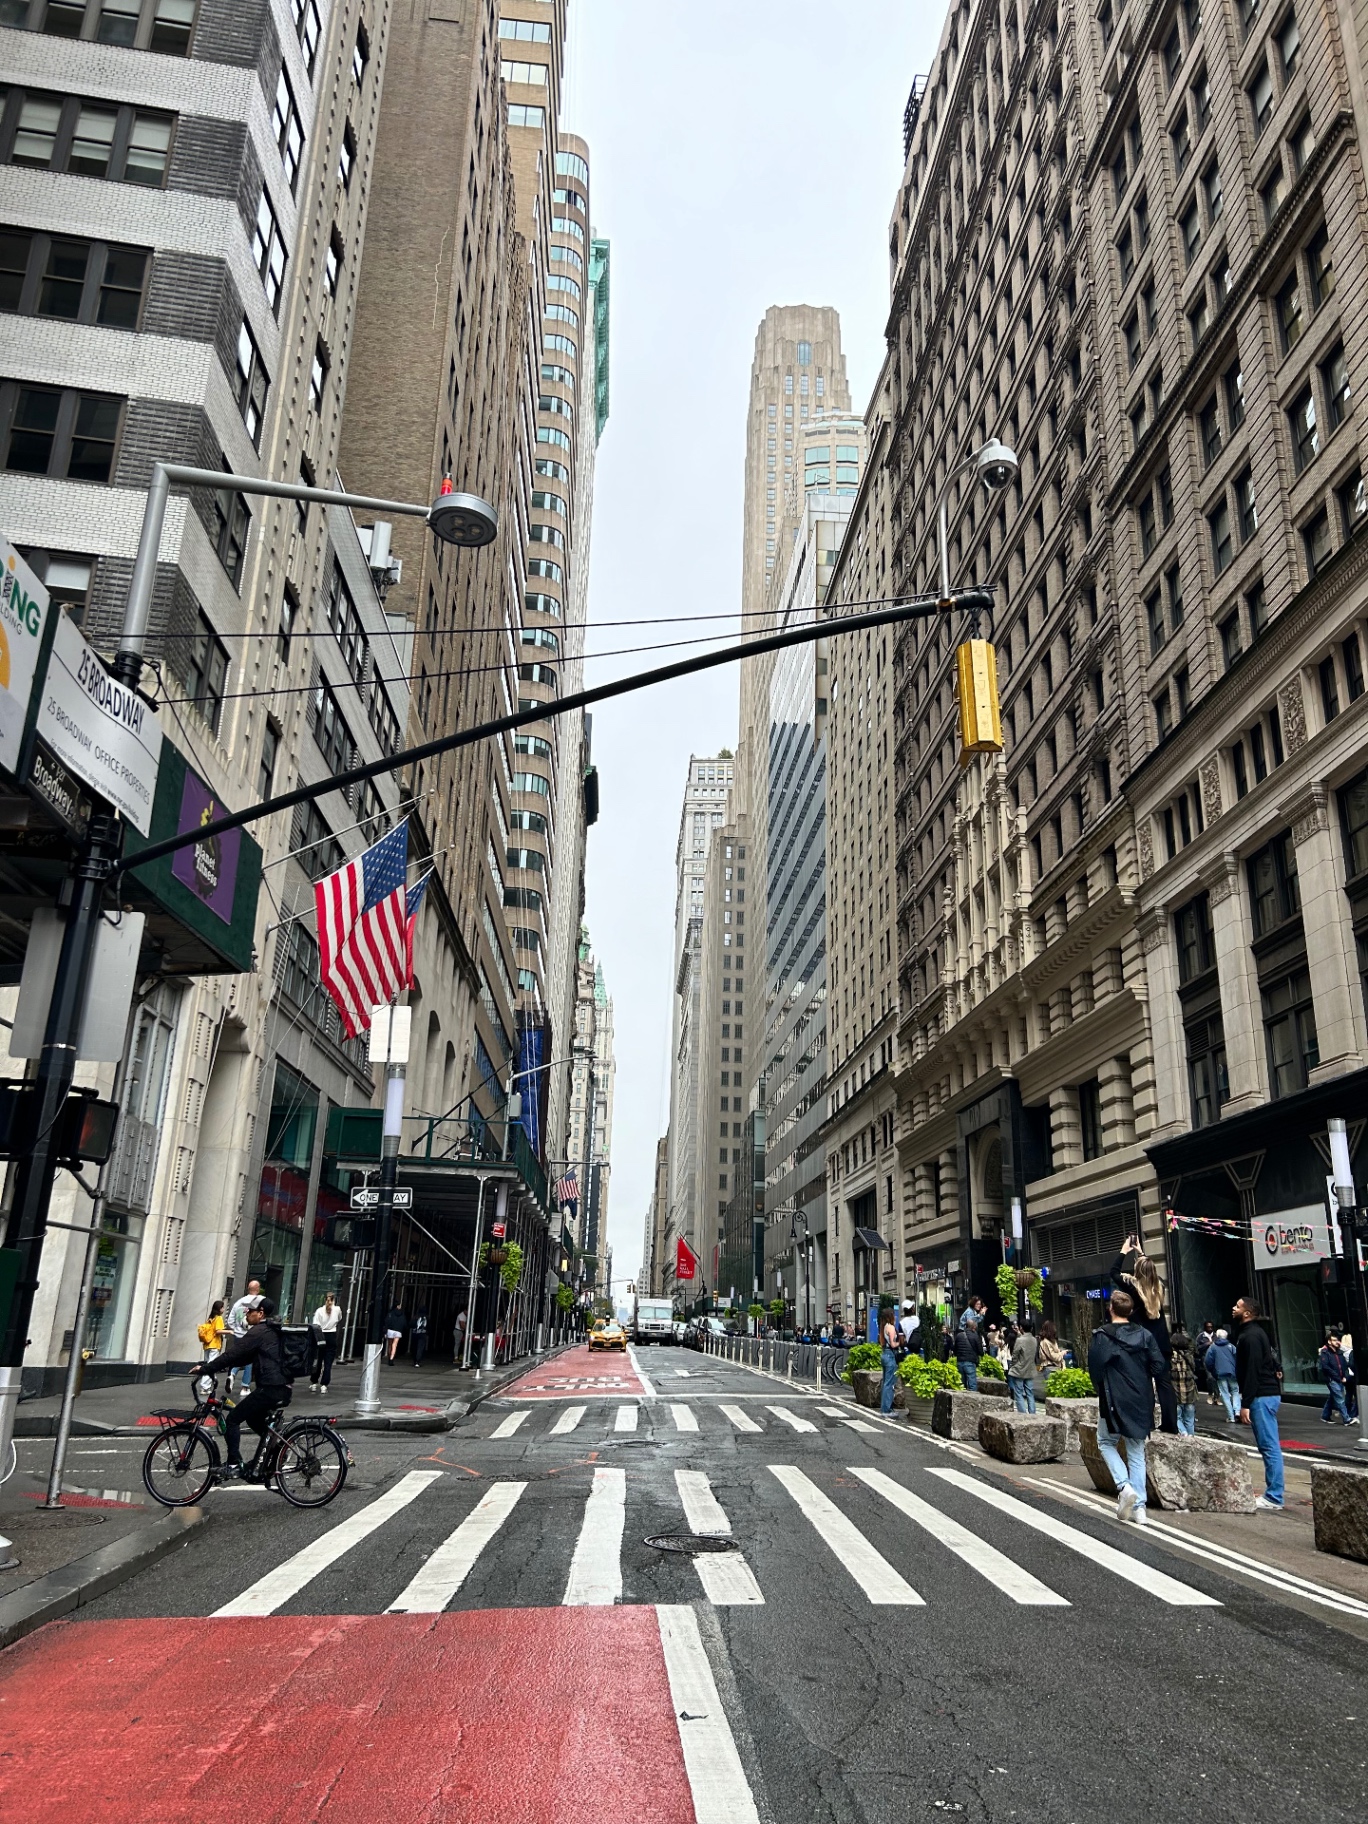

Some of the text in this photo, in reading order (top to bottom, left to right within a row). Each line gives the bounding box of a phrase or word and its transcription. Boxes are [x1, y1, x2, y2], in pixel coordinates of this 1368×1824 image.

[77, 649, 144, 735] 25 BROADWAY
[47, 697, 150, 805] 25 BROADWAY OFFICE PROPERTIES
[33, 755, 73, 816] Broadway
[194, 843, 216, 871] planet
[196, 857, 218, 887] fitness
[359, 1193, 406, 1202] ONE AY
[1279, 1223, 1313, 1245] bento
[1086, 1289, 1101, 1299] CHASE
[523, 1383, 631, 1392] ONLY
